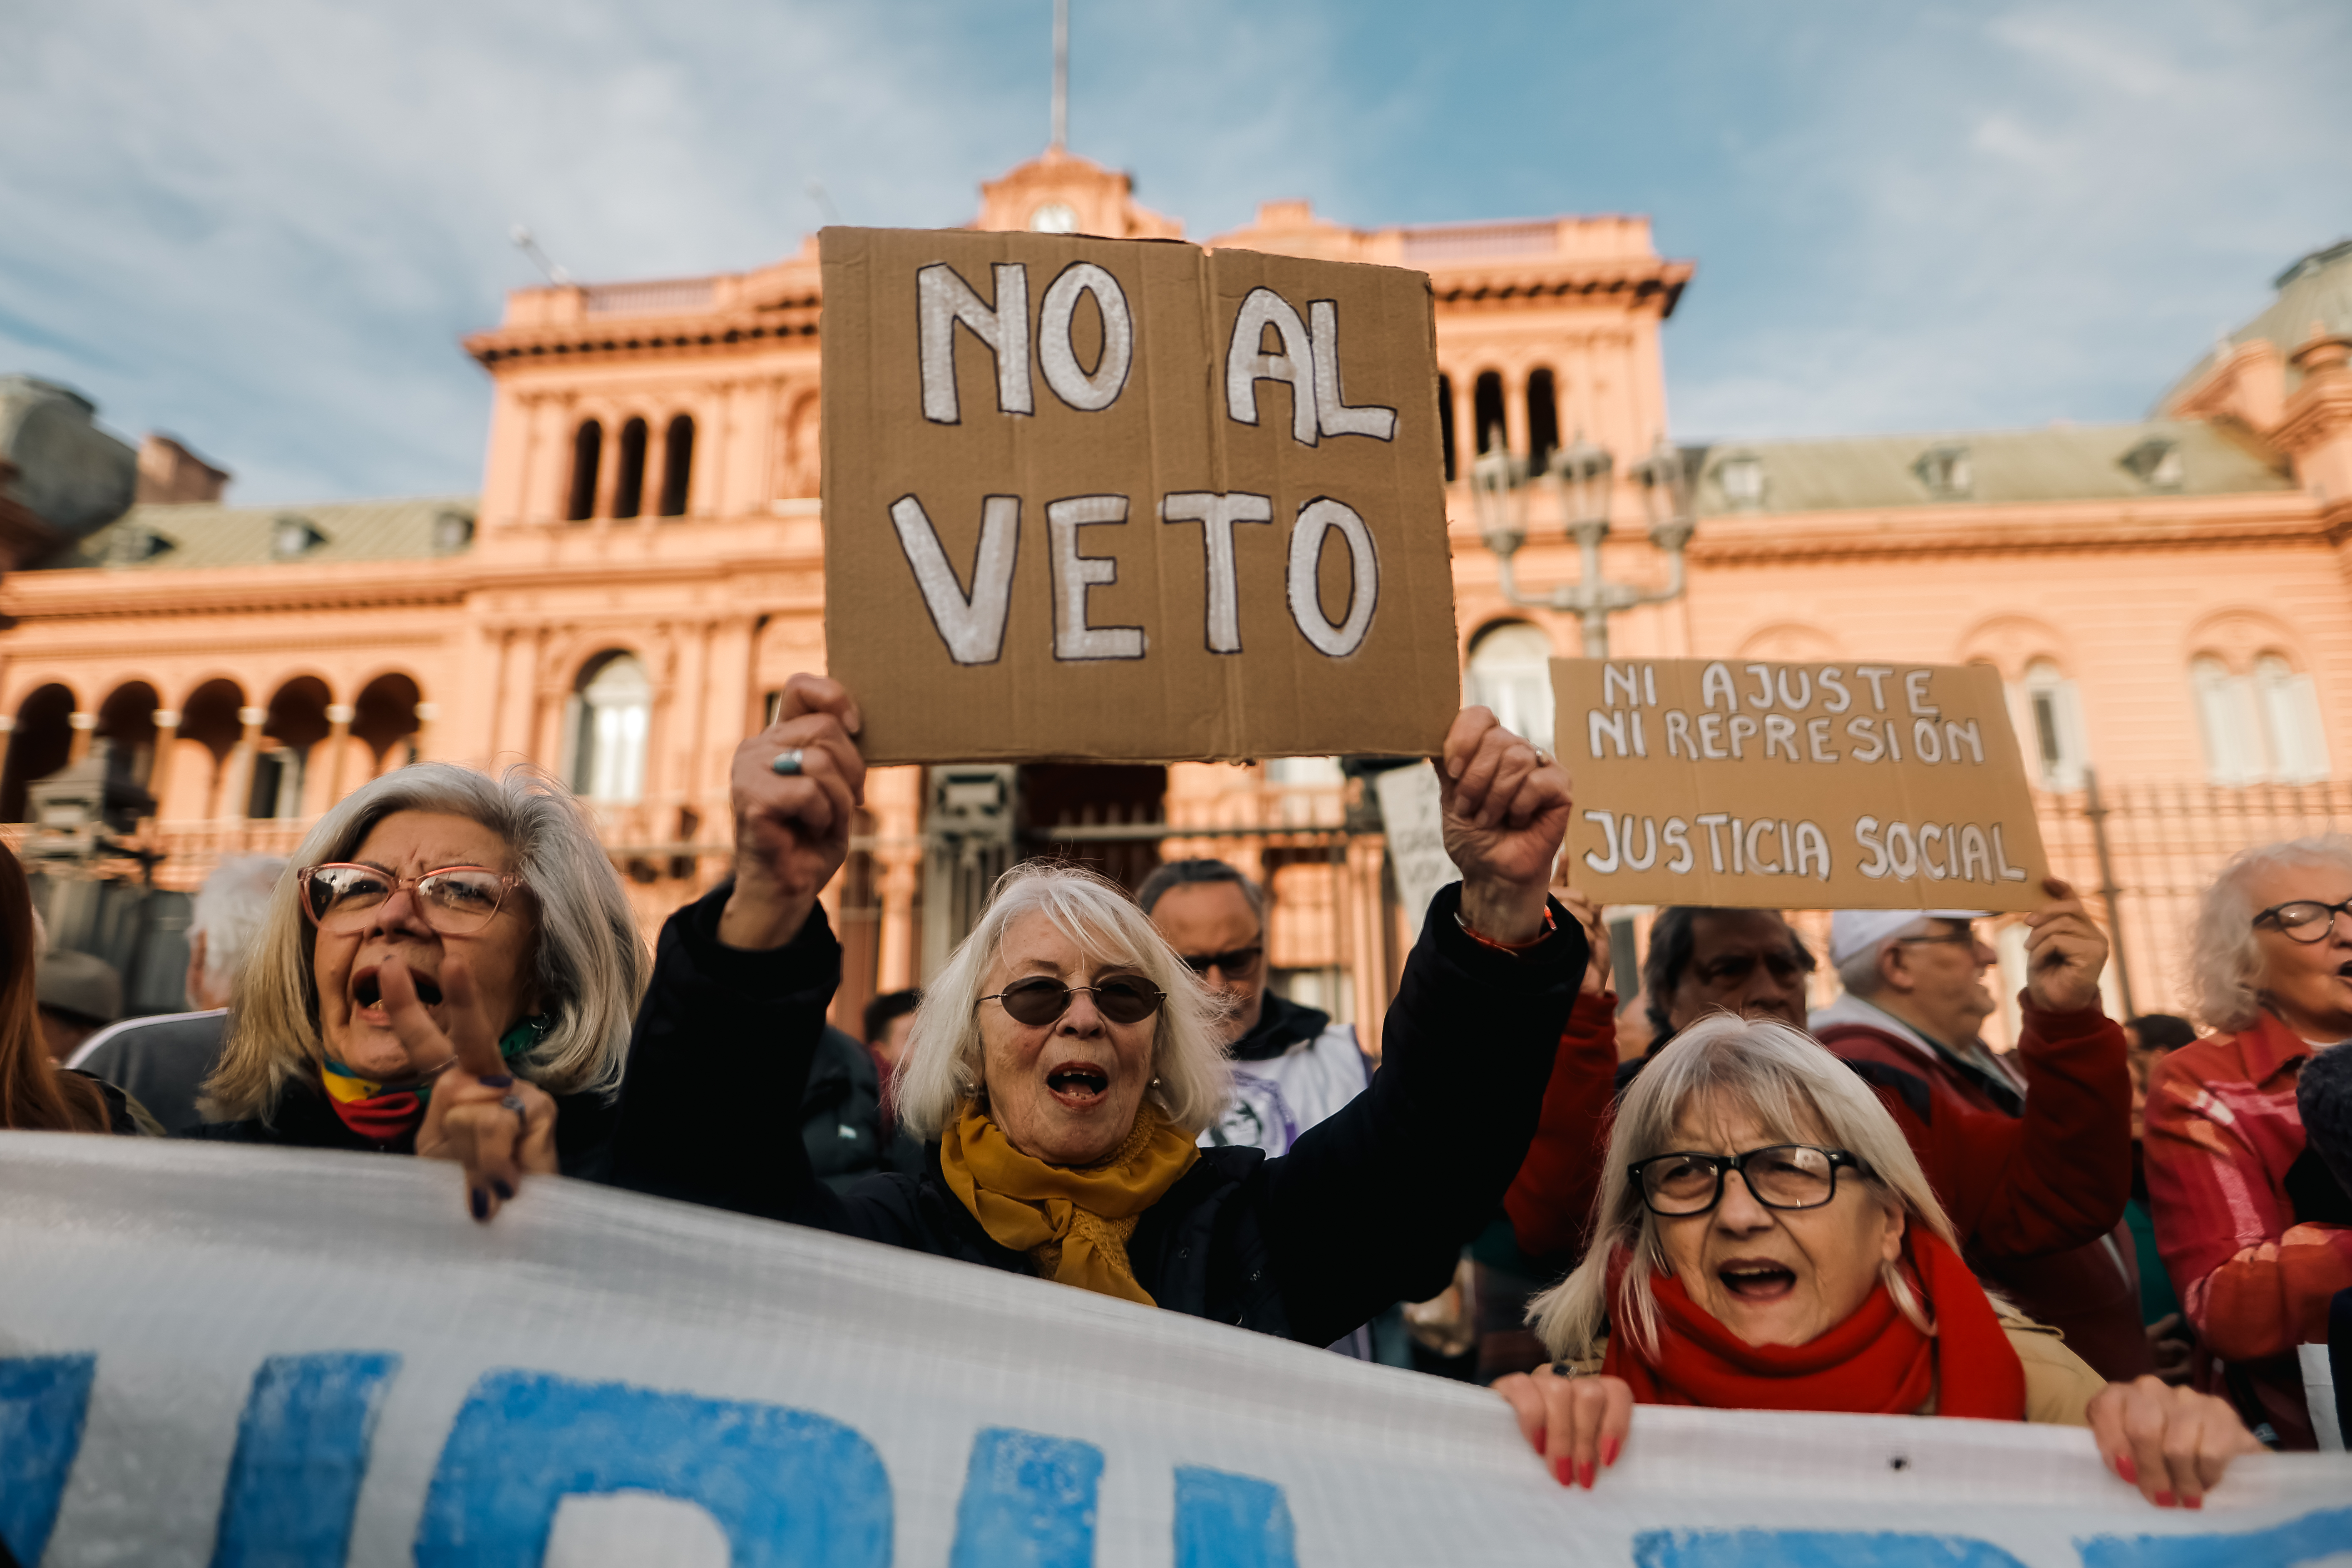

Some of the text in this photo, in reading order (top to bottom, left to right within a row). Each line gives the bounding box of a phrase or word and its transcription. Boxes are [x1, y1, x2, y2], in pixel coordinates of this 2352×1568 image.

[916, 261, 1398, 447] NO AL
[888, 491, 1379, 665] VETO
[1602, 661, 1940, 717] NI AJUSTE
[1587, 709, 1648, 759] NI
[1582, 809, 2028, 885] JUSTICIA SOCIAL
